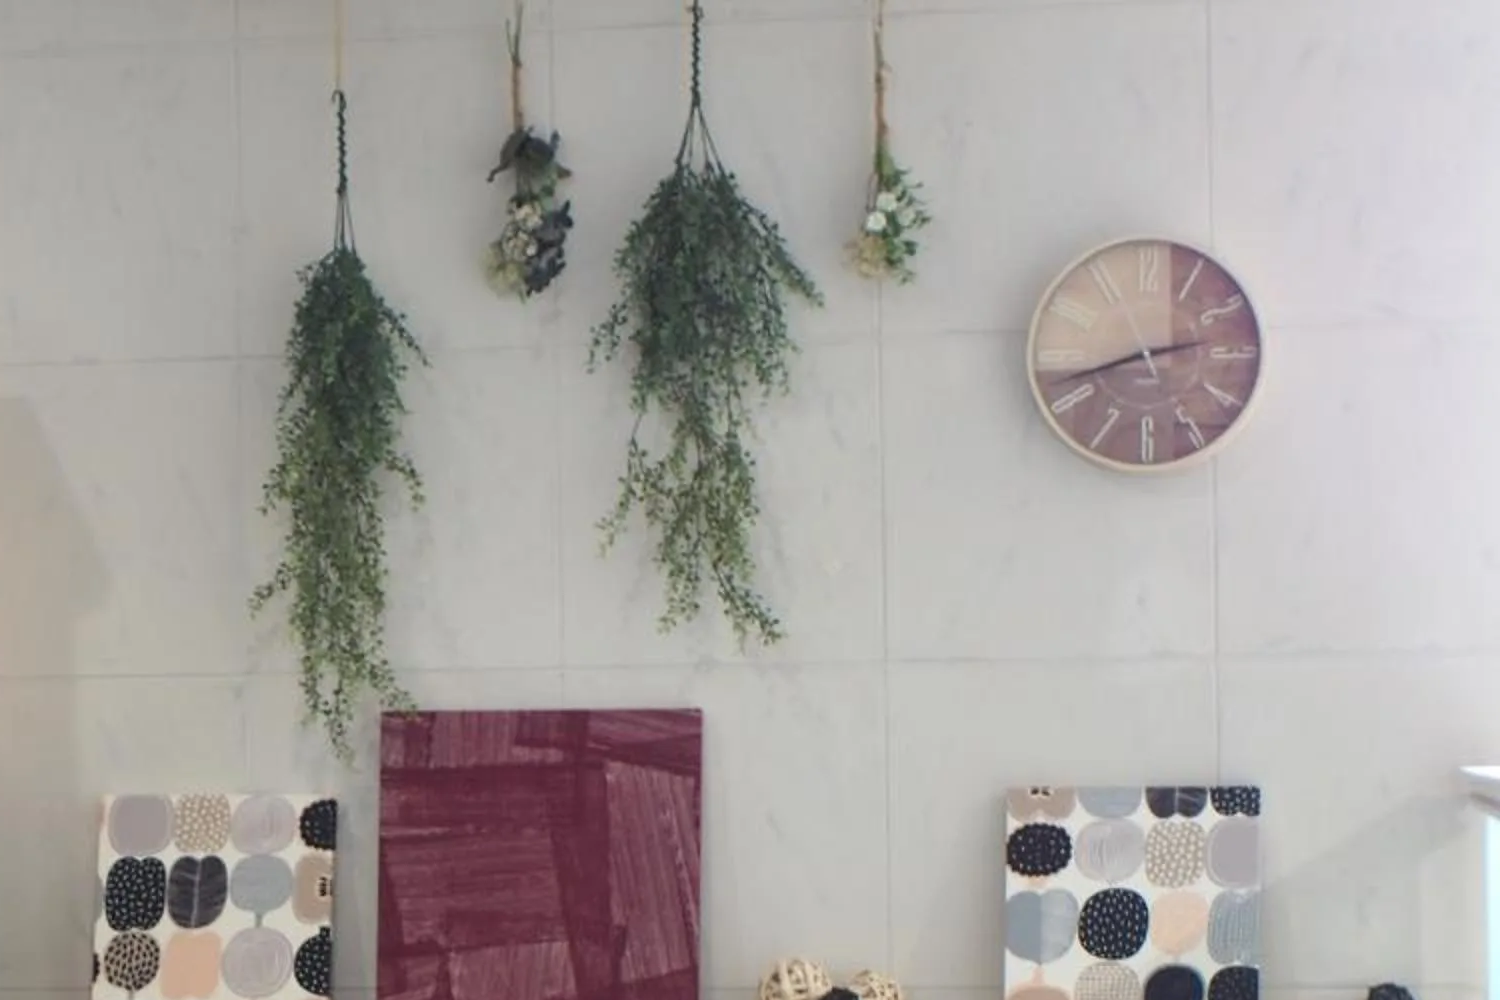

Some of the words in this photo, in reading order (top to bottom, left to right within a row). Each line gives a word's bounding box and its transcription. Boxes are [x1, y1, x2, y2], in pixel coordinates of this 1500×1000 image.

[1138, 247, 1158, 292] 12
[1179, 259, 1204, 301] 1
[1201, 294, 1242, 325] 2
[1210, 346, 1256, 358] 3
[1051, 383, 1095, 414] 8
[1204, 382, 1242, 407] 4
[1090, 407, 1120, 449] 7
[1141, 415, 1154, 463] 6
[1176, 405, 1205, 449] 5
